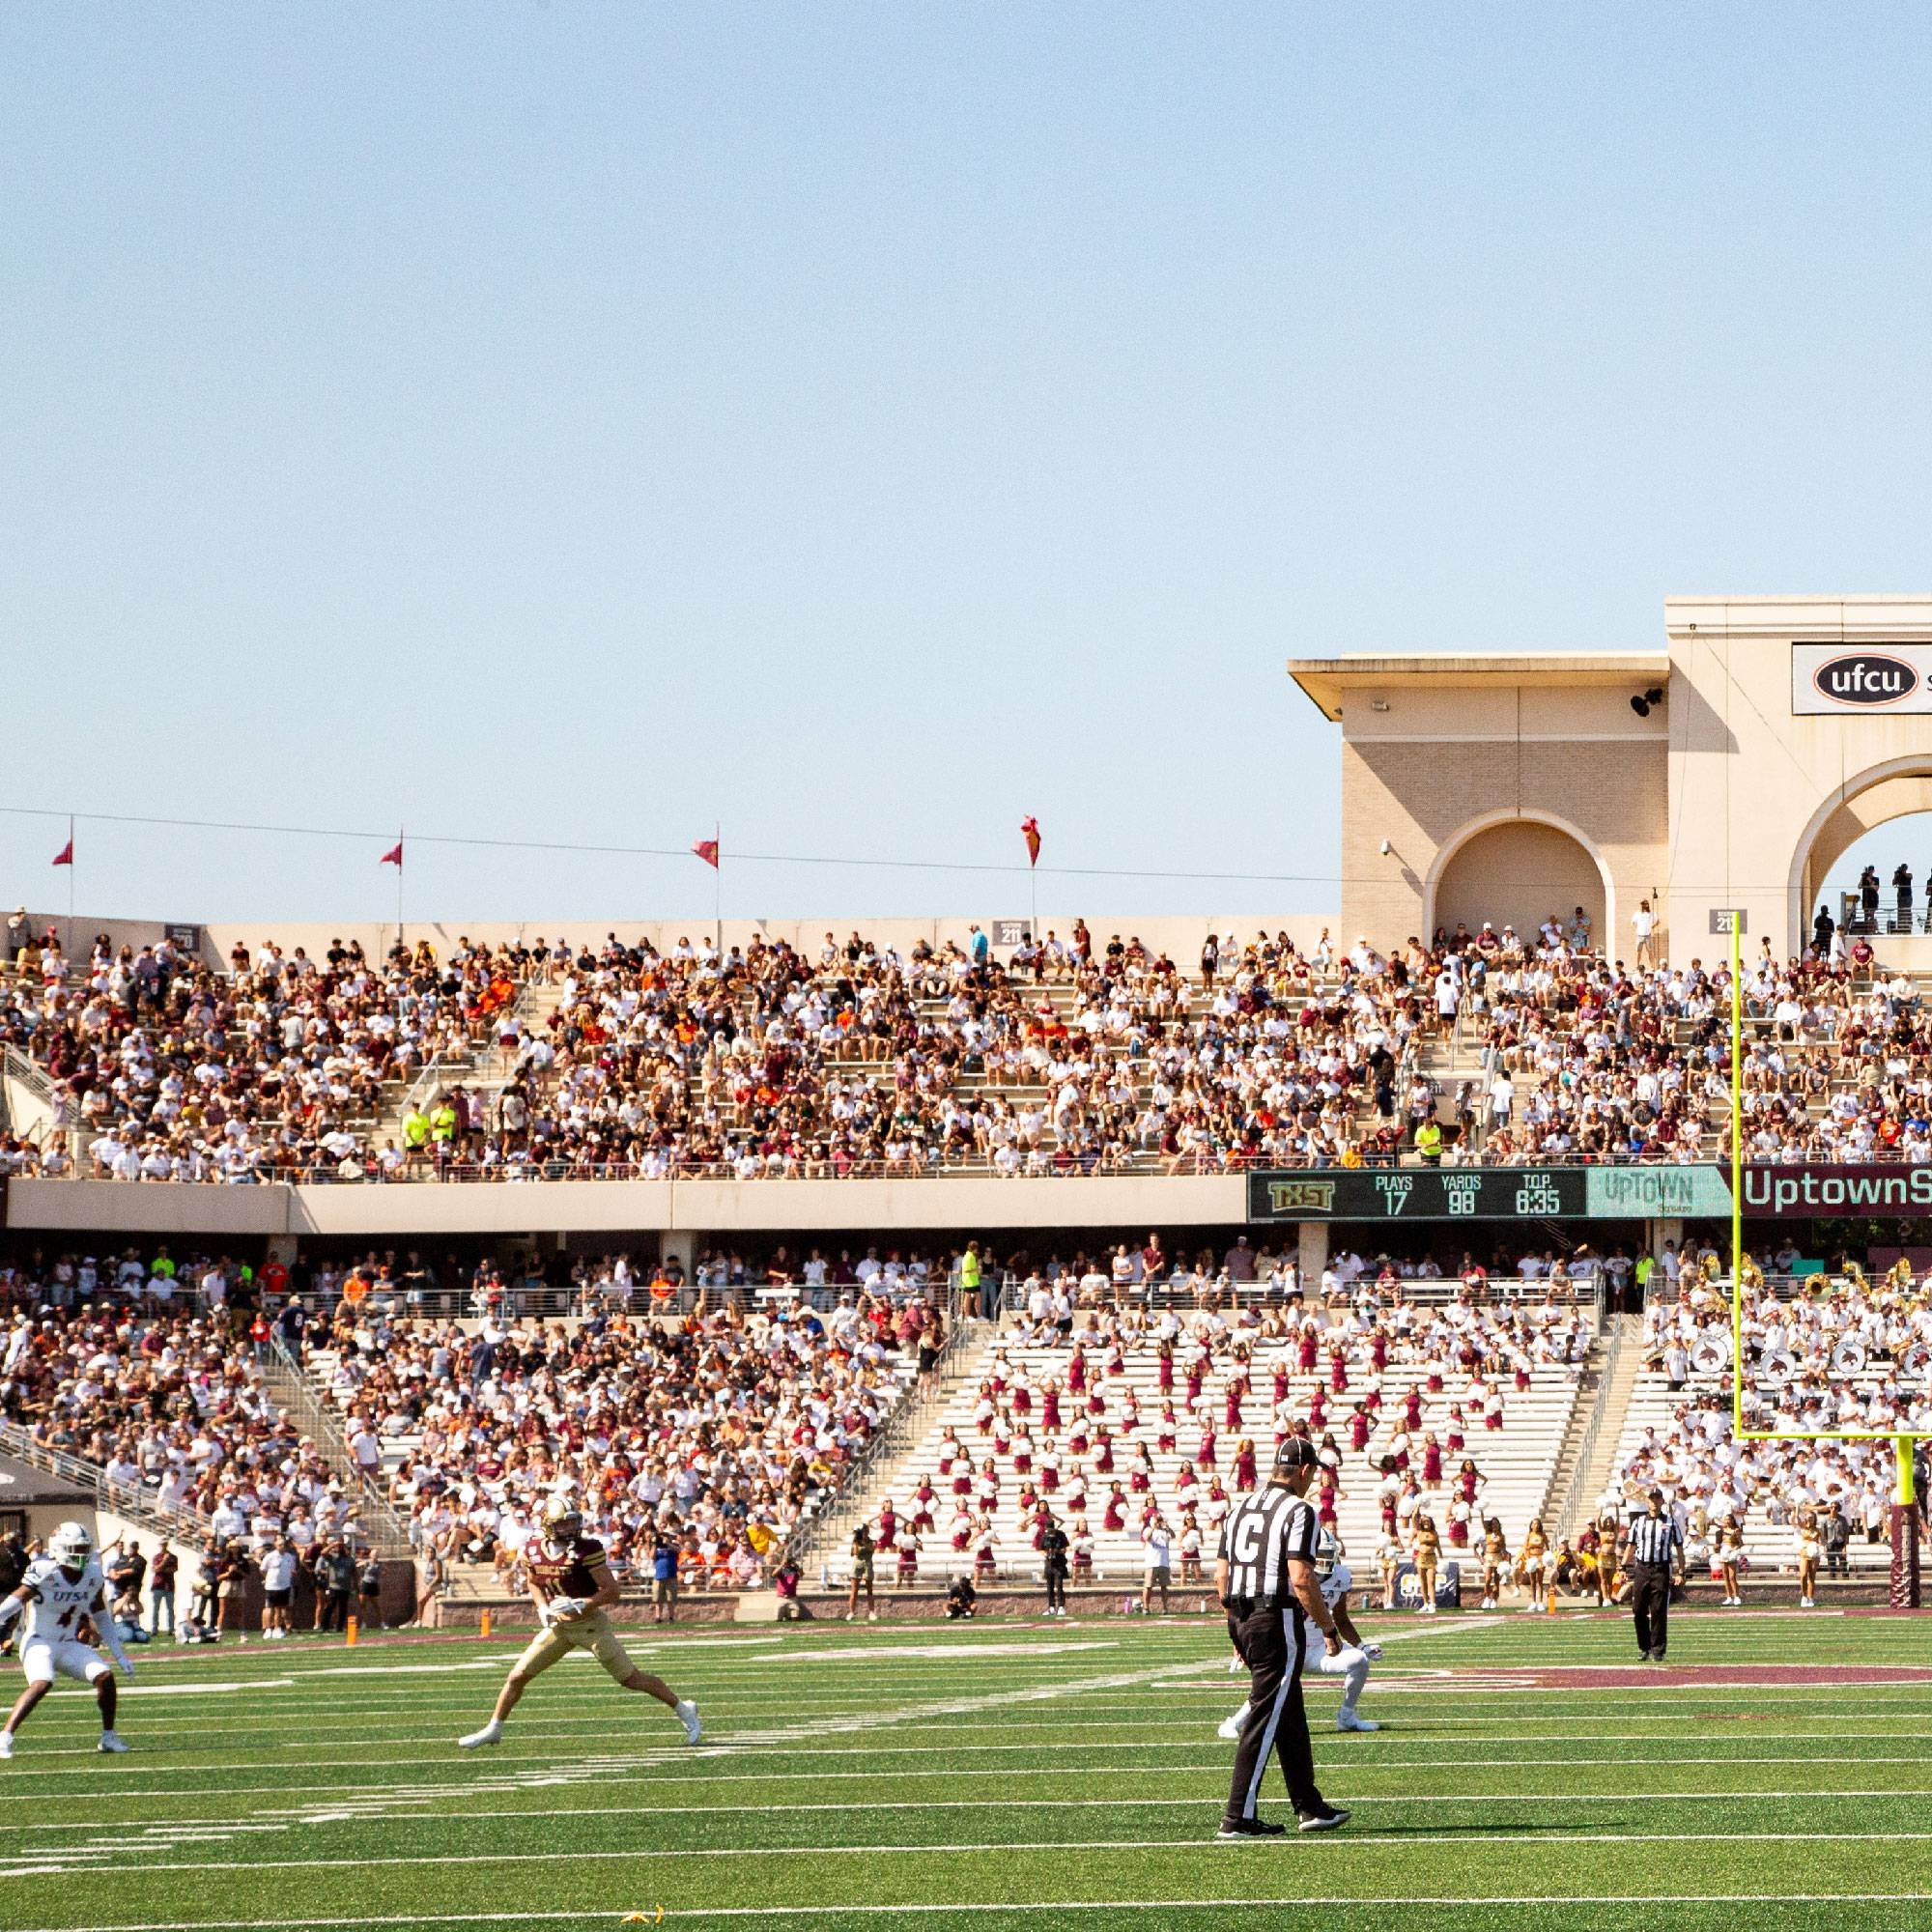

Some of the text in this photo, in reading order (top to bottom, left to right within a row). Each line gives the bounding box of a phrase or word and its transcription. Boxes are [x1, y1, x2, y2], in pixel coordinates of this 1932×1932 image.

[1832, 663, 1900, 692] ufcu
[1001, 928, 1021, 943] 211
[1717, 917, 1736, 931] 21
[1376, 1176, 1413, 1191] PLAYS
[1441, 1175, 1482, 1190] YARDS
[1269, 1183, 1332, 1208] TXST
[1384, 1191, 1407, 1216] 17
[1449, 1190, 1475, 1214] 98
[1234, 1513, 1265, 1563] C
